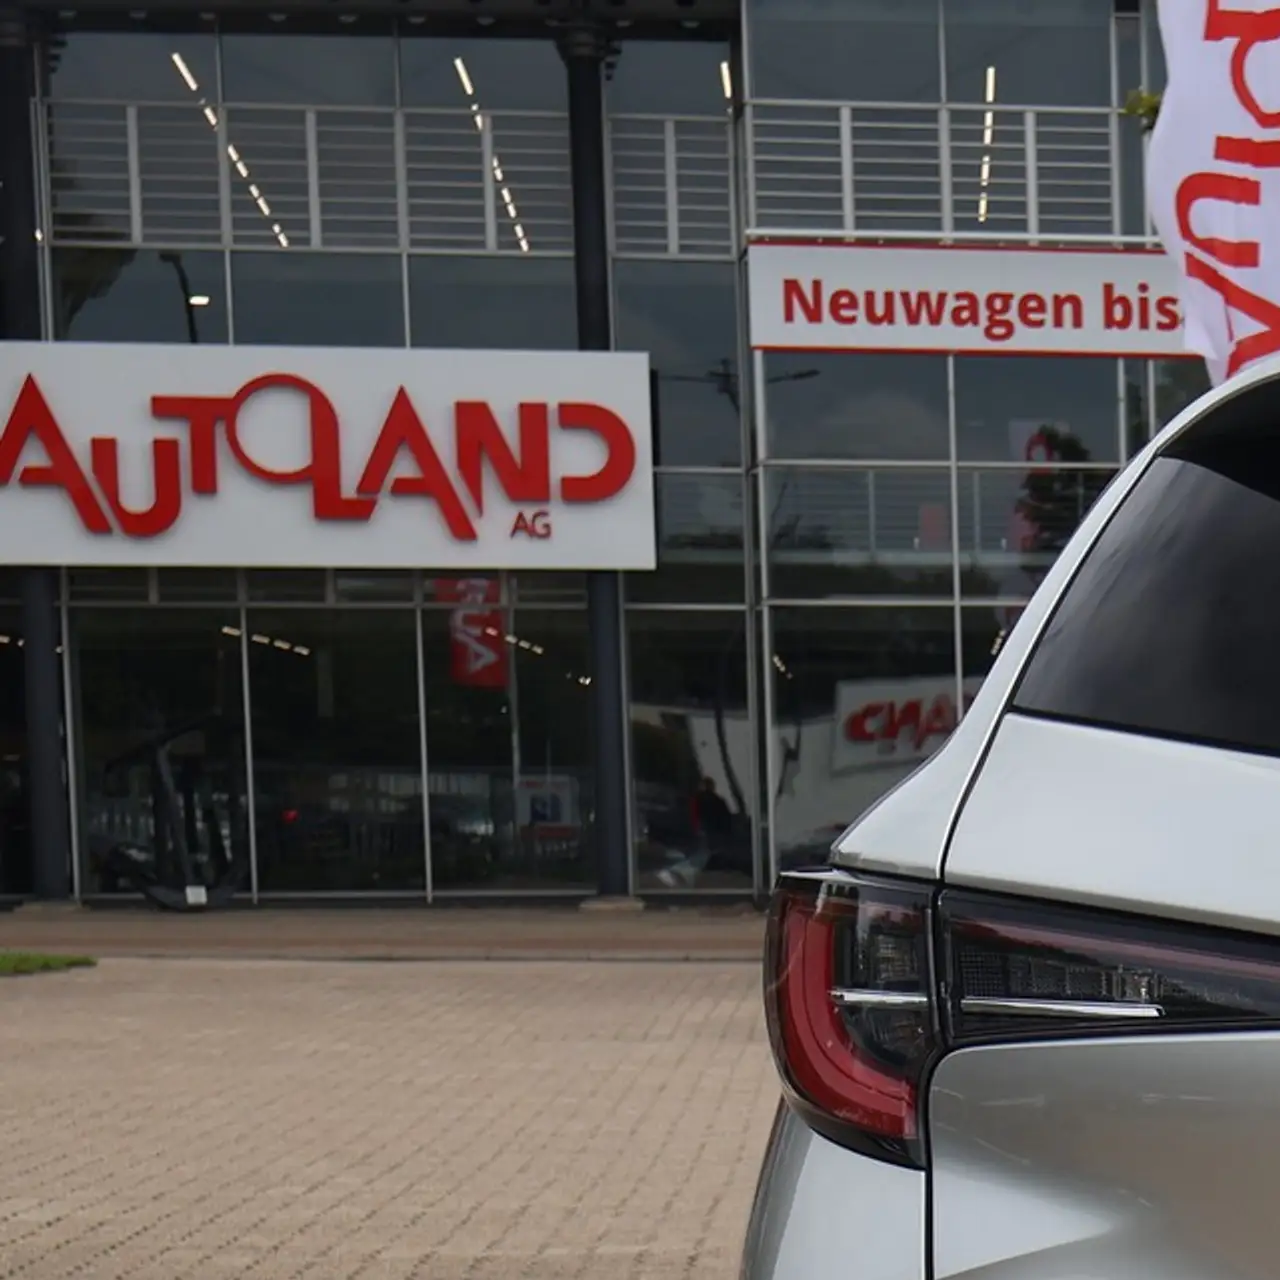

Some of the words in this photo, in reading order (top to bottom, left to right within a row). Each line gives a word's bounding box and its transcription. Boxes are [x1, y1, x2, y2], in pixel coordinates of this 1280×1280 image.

[782, 279, 1084, 342] Neuwagen
[1103, 282, 1180, 331] bis
[0, 372, 637, 541] AUTOLAND
[511, 511, 552, 539] AG
